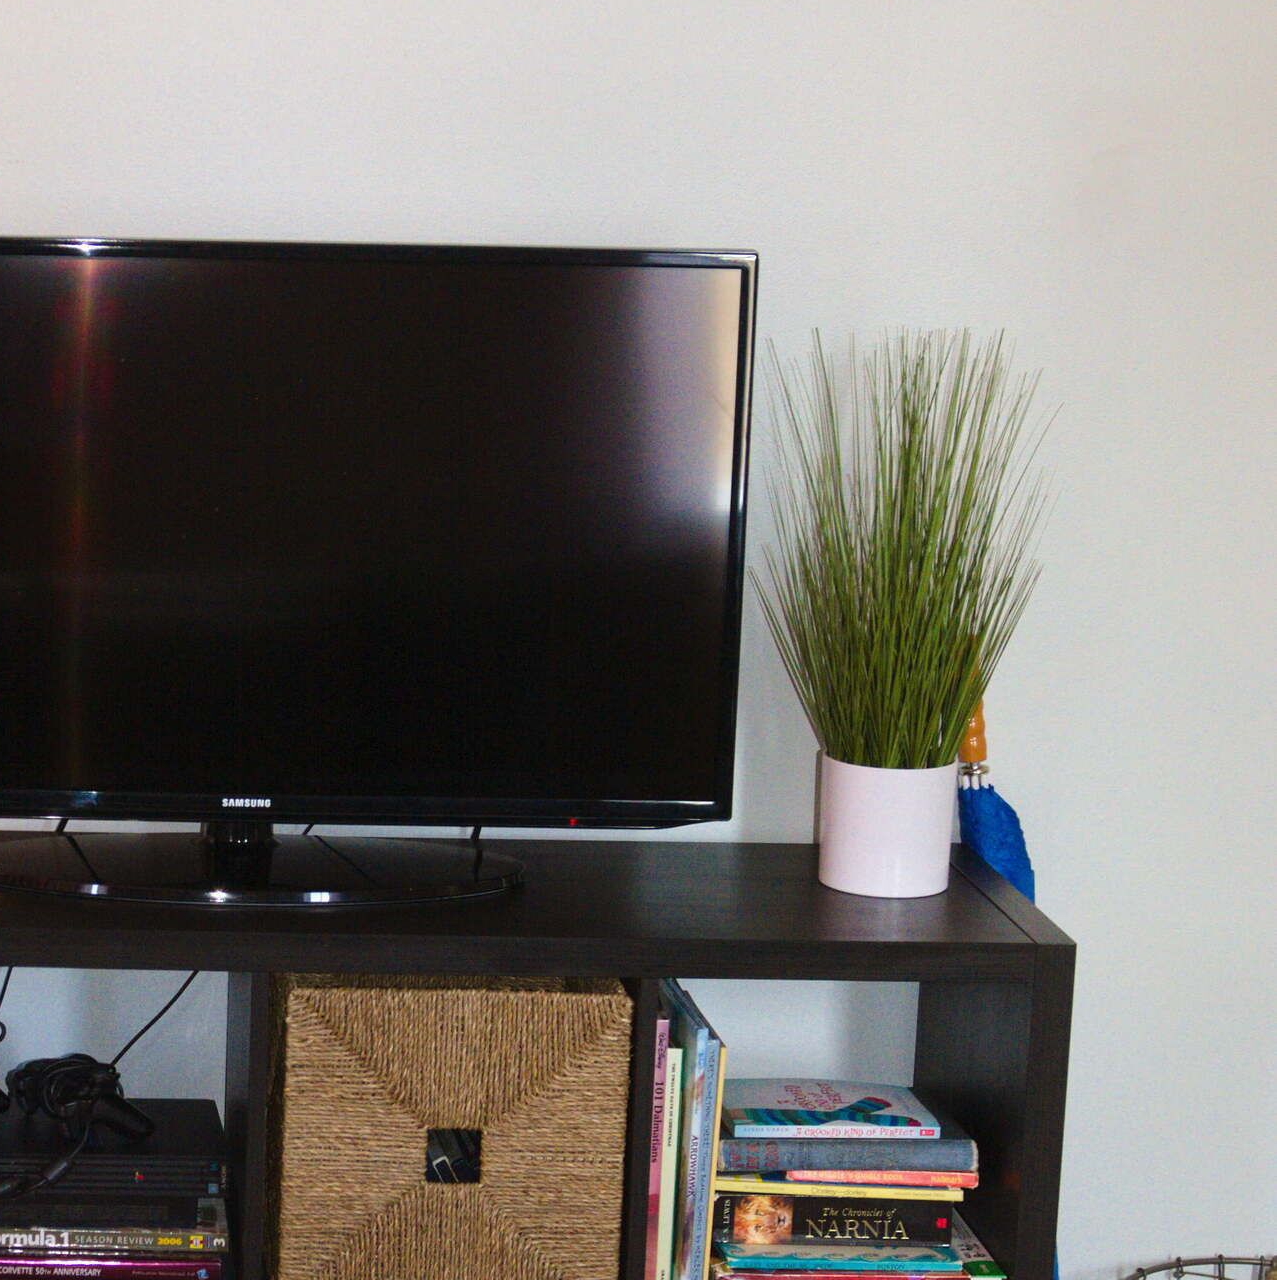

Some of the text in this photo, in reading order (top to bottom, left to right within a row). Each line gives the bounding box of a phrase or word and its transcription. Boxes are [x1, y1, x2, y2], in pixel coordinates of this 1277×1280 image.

[221, 798, 271, 808] SAMSUNG
[651, 1082, 664, 1163] 101 Dalmatians
[687, 1136, 699, 1199] ARROWHAWK
[723, 1199, 731, 1224] LEWIS
[823, 1208, 897, 1219] The Chronicles of
[60, 1231, 70, 1246] 1
[74, 1235, 113, 1244] SEASON
[117, 1236, 154, 1245] REVIEW
[805, 1219, 910, 1240] NARNIA
[53, 1267, 102, 1277] ANNIVERSARY
